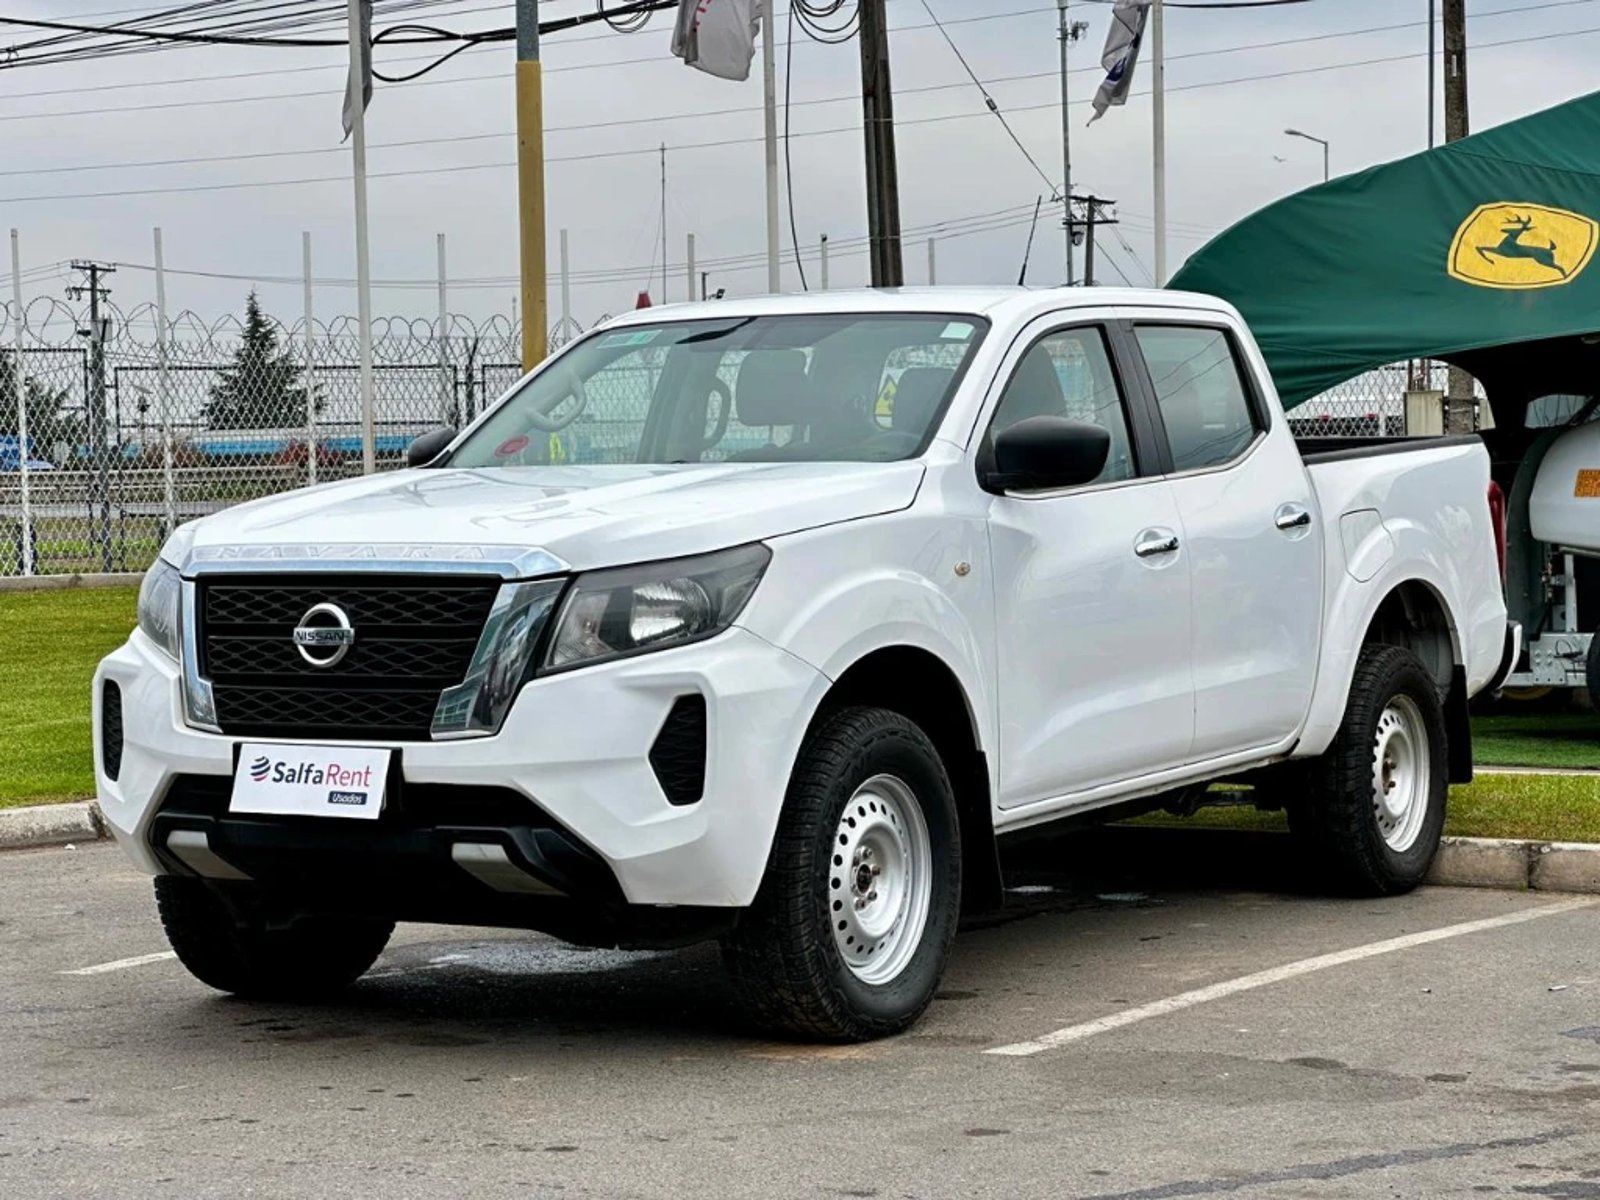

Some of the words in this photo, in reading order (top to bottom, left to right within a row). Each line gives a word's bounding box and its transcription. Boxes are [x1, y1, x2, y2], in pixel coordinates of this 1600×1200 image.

[217, 545, 486, 560] NAVARA
[296, 630, 345, 642] NISSAN
[272, 761, 372, 787] SalfaRent
